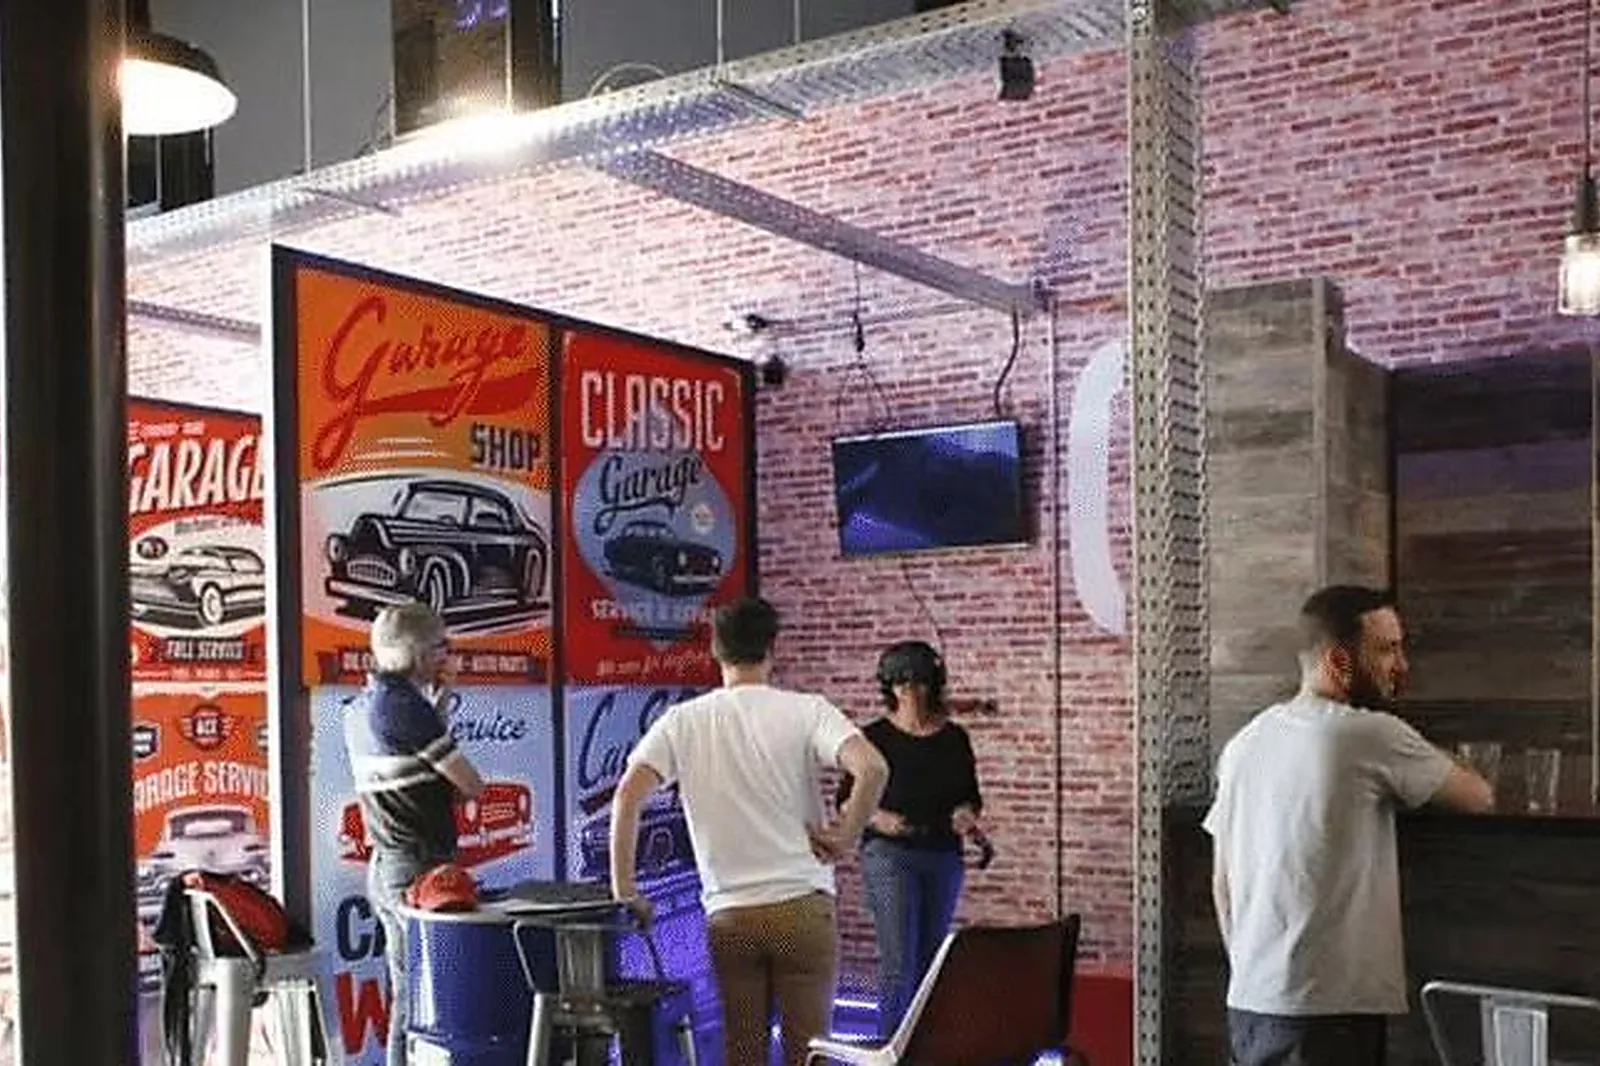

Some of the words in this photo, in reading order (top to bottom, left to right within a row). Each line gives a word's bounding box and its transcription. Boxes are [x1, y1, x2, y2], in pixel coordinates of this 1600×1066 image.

[312, 296, 528, 470] Garage
[580, 369, 726, 452] CLASSIC
[468, 421, 541, 472] SHOP
[594, 451, 703, 535] Garage
[133, 761, 199, 815] ARAGE
[203, 760, 268, 798] SERVI
